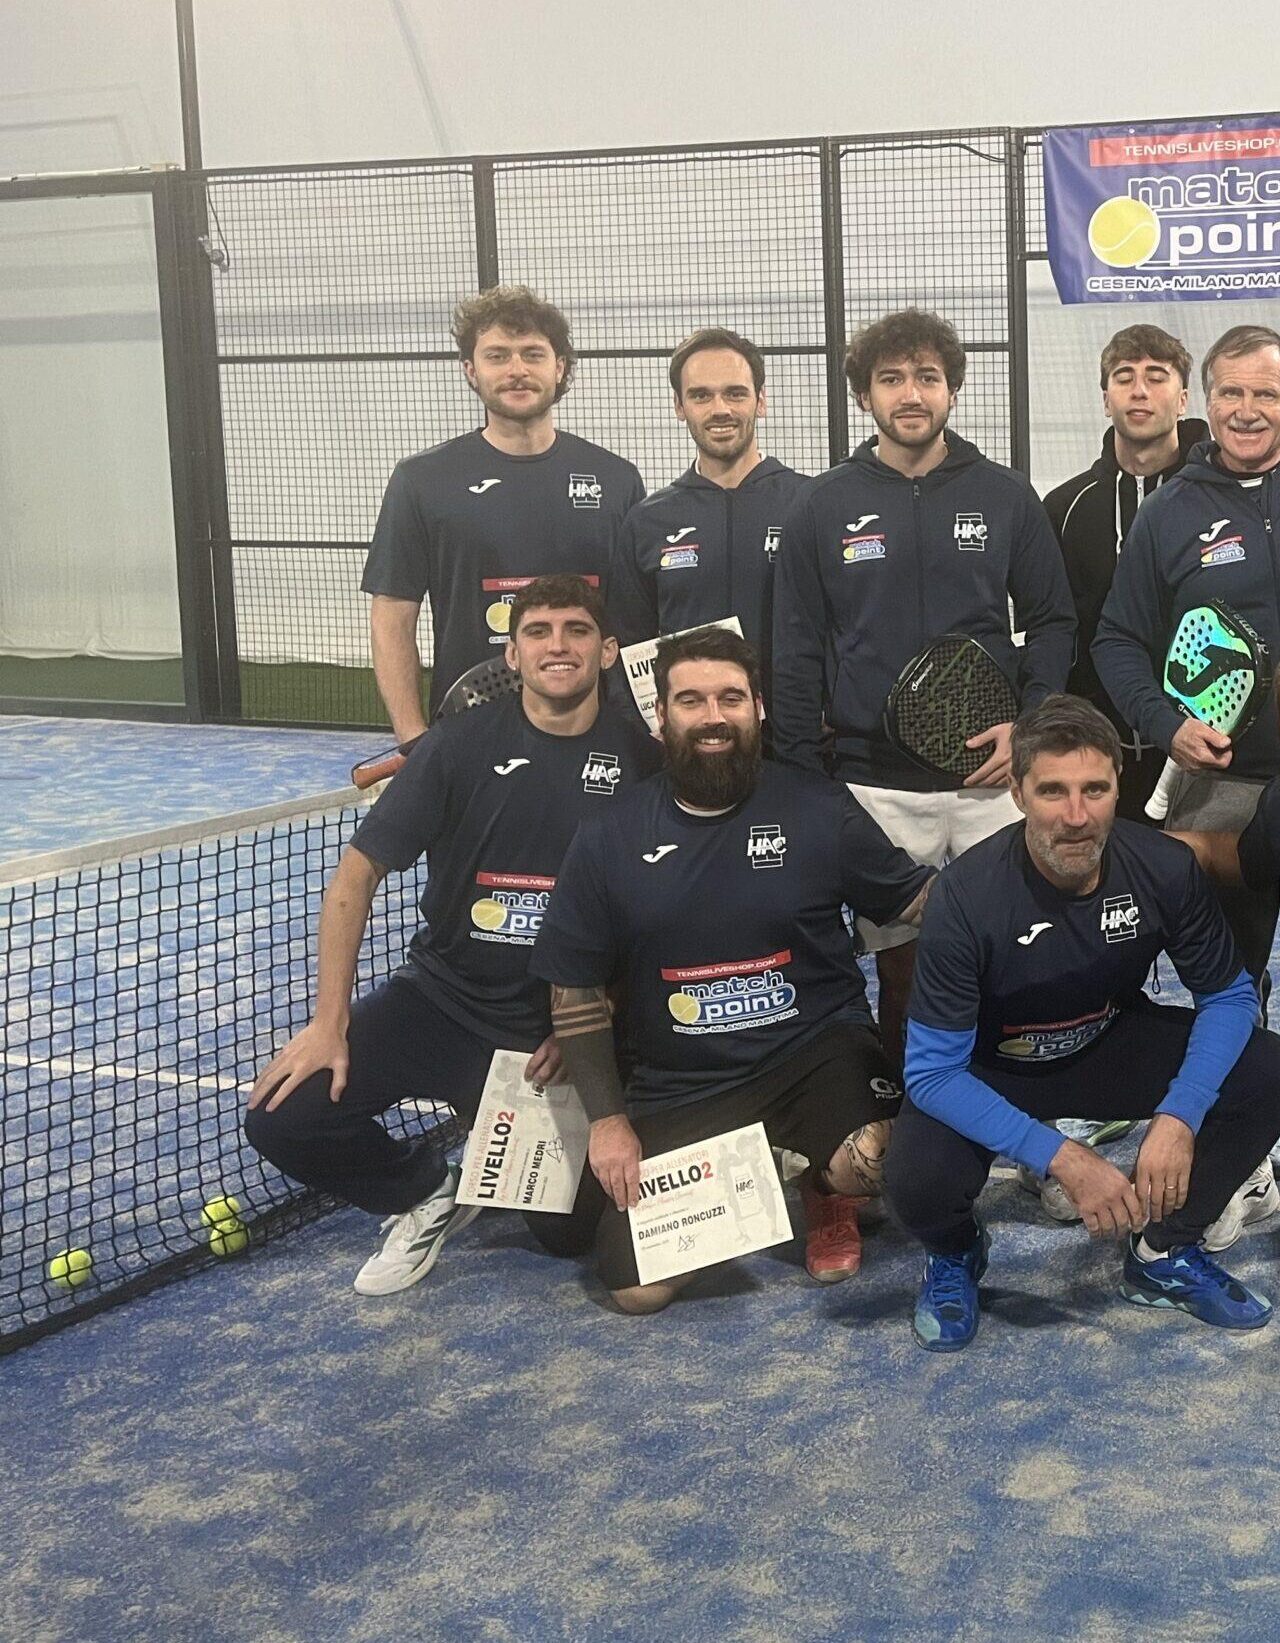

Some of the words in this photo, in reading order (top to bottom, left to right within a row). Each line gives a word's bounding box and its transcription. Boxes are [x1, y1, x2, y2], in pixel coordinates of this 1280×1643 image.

[569, 483, 602, 498] HAC
[954, 523, 988, 540] HAC
[640, 701, 655, 711] LUCA
[581, 763, 621, 784] HAC
[747, 836, 787, 856] HAC
[1100, 906, 1141, 931] HAC
[677, 958, 776, 977] TENNISLIVESHOP.COM
[681, 969, 783, 998] match
[705, 990, 784, 1023] point
[523, 1172, 539, 1204] MARCO
[534, 1141, 547, 1169] MEDRI
[638, 1161, 714, 1200] IVELLO2
[638, 1219, 679, 1240] DAMIANO
[682, 1205, 726, 1226] RONCUZZI
